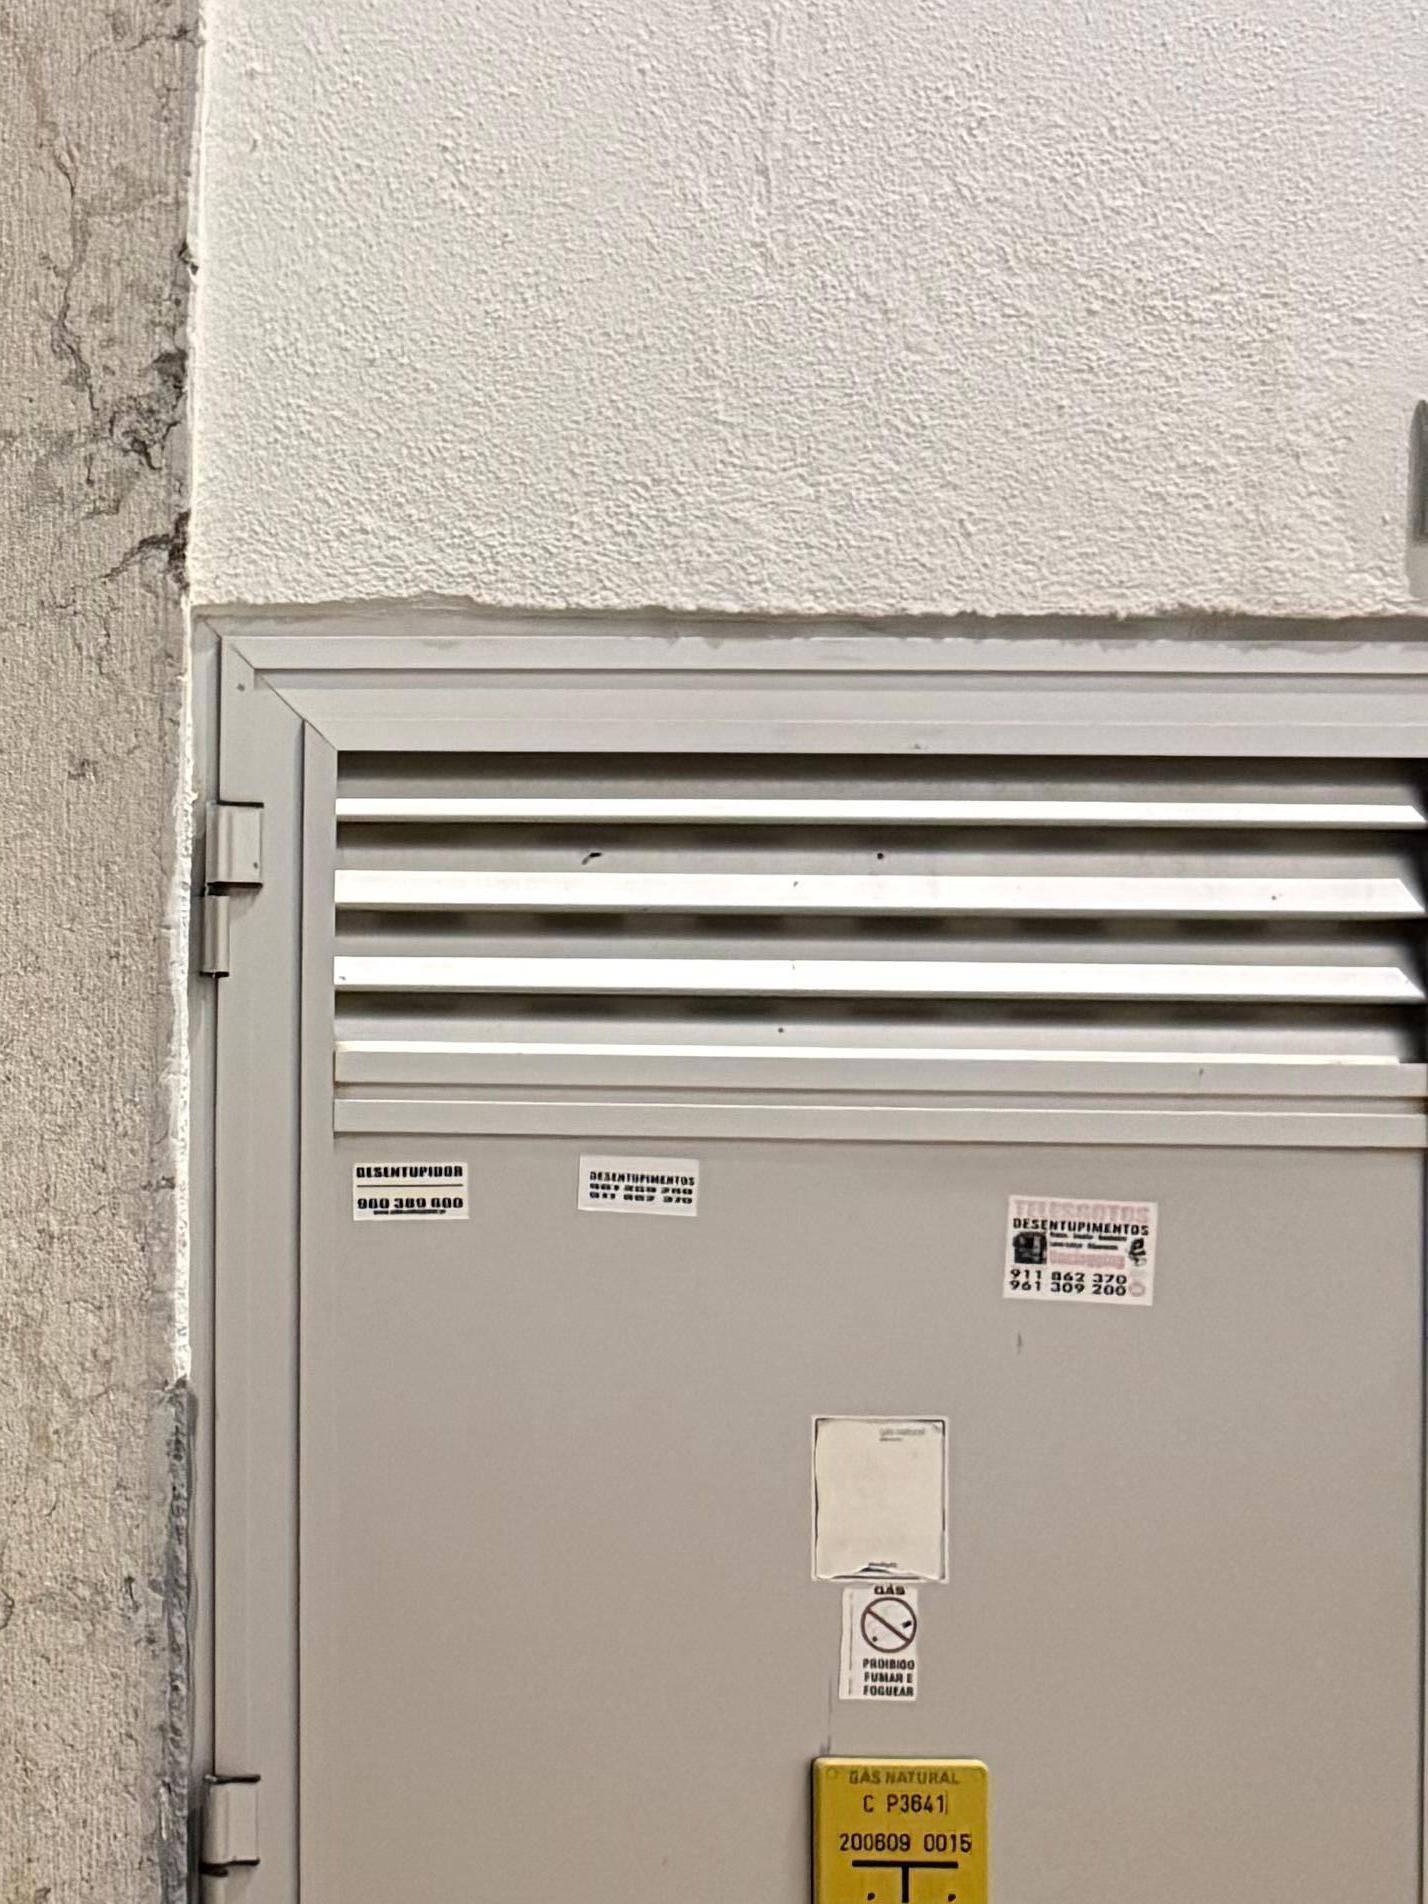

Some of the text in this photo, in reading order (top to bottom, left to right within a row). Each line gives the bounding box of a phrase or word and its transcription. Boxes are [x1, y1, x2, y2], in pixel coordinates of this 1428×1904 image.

[1013, 1218, 1149, 1236] DESENTUPIMENTOS
[1010, 1269, 1042, 1279] 911
[1009, 1280, 1041, 1291] 961
[1092, 1284, 1127, 1296] 200
[864, 1672, 913, 1684] FUMAR E
[885, 1771, 960, 1785] NATURAL
[863, 1794, 944, 1813] C P3641
[924, 1834, 972, 1853] 0015
